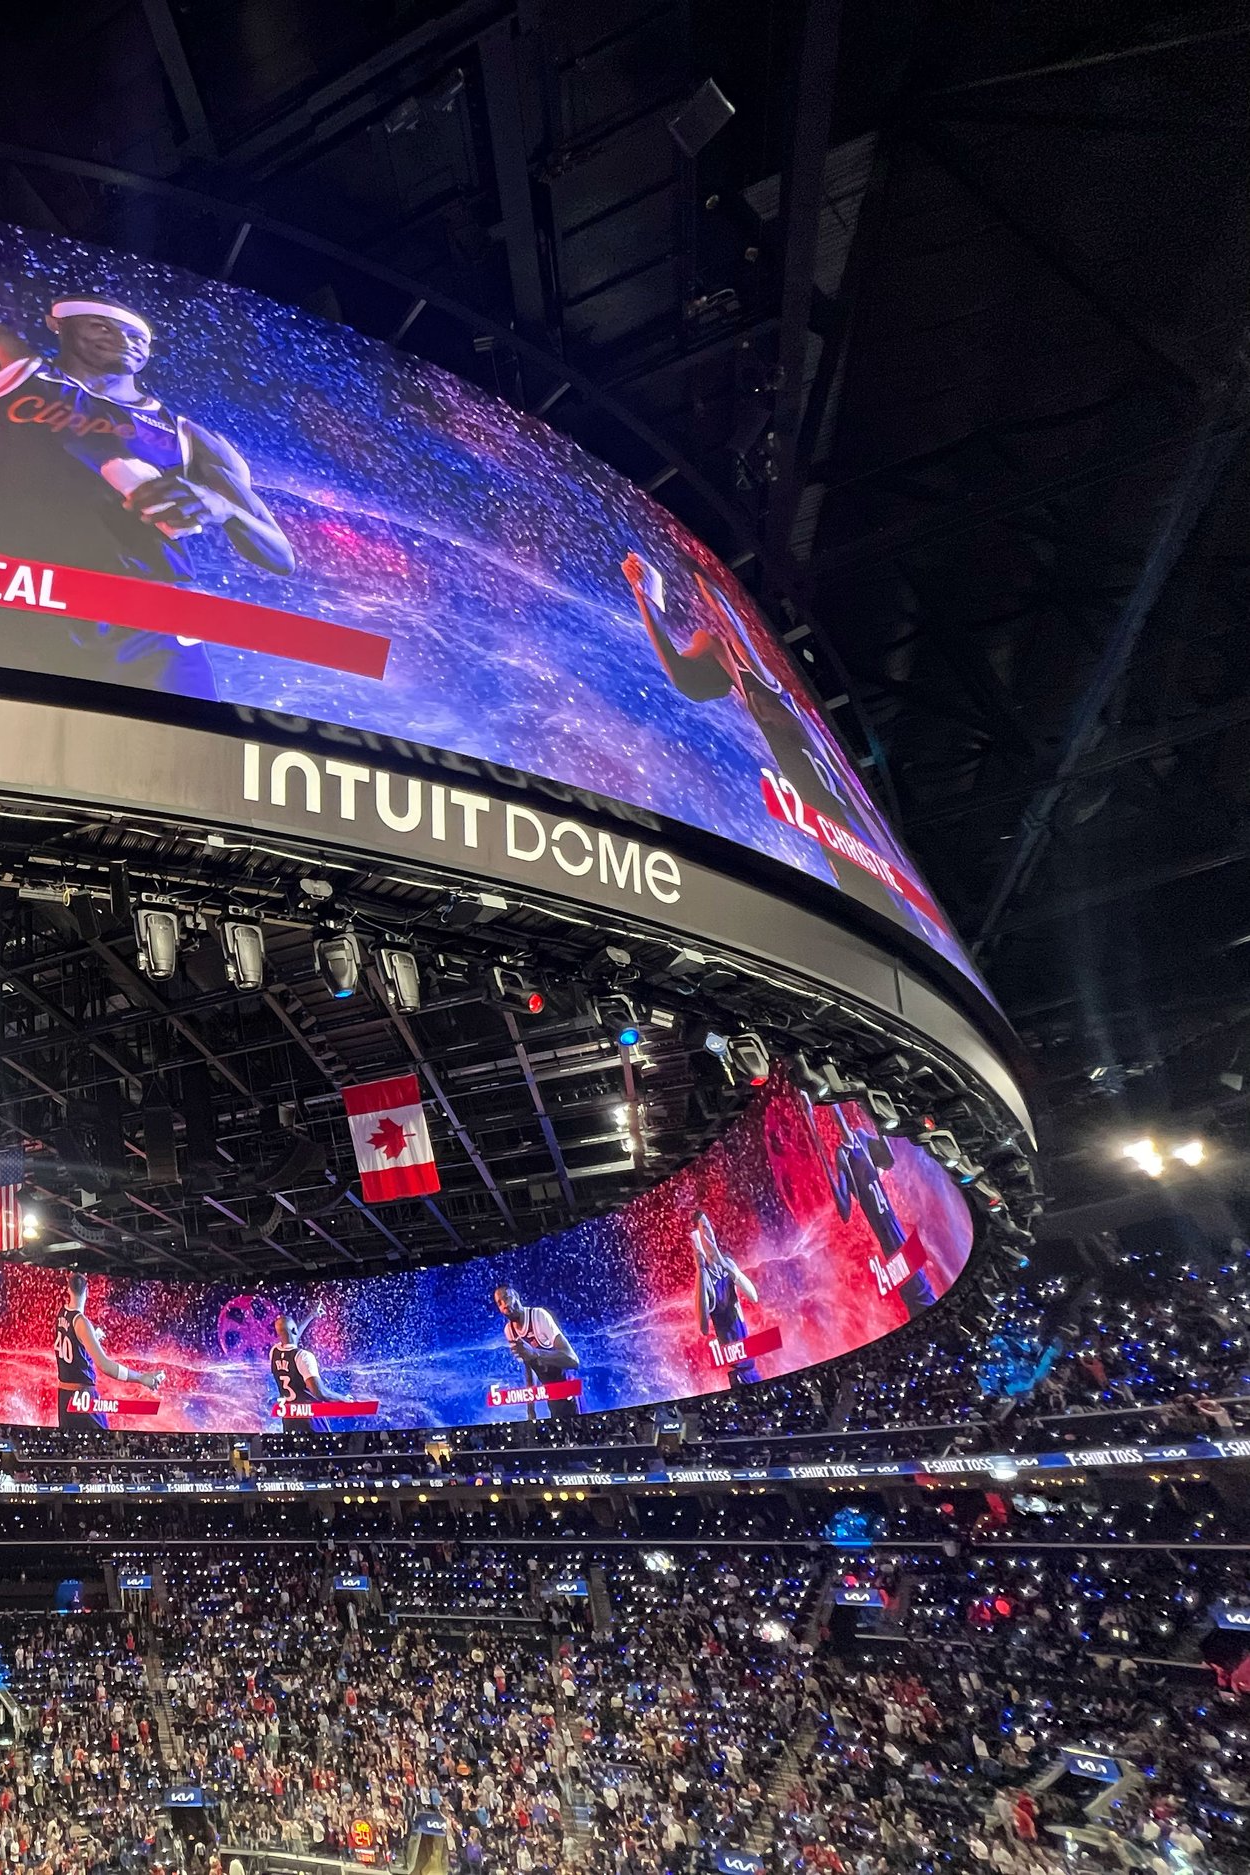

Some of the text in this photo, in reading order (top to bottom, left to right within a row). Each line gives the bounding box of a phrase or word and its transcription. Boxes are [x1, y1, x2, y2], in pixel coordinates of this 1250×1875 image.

[243, 743, 490, 849] INTUIT
[760, 767, 904, 894] 12 CHRISTIE
[868, 1255, 892, 1296] 24
[54, 1331, 74, 1363] 40
[709, 1339, 747, 1366] 11 LOPEZ
[72, 1390, 119, 1413] 40 ZUBAC
[490, 1384, 502, 1406] 5
[505, 1388, 534, 1404] JONES
[276, 1397, 314, 1417] 3 PAUL
[922, 1460, 964, 1473] T-SHIRT
[964, 1458, 995, 1471] TOSS
[1066, 1451, 1112, 1467] T-SHIRT
[1111, 1449, 1144, 1463] TOSS
[553, 1475, 589, 1486] T-SHIRT
[589, 1474, 612, 1484] TOSS
[667, 1471, 706, 1482] T-SHIRT
[706, 1470, 731, 1481] TOSS
[788, 1466, 830, 1478] T-SHIRT
[830, 1464, 858, 1477] TOSS
[79, 1483, 106, 1493] T-SHIRT
[106, 1484, 124, 1493] TOSS
[167, 1483, 194, 1493] T-SHIRT
[194, 1483, 213, 1493] TOSS
[256, 1482, 285, 1492] T-SHIRT
[285, 1481, 304, 1491] TOSS
